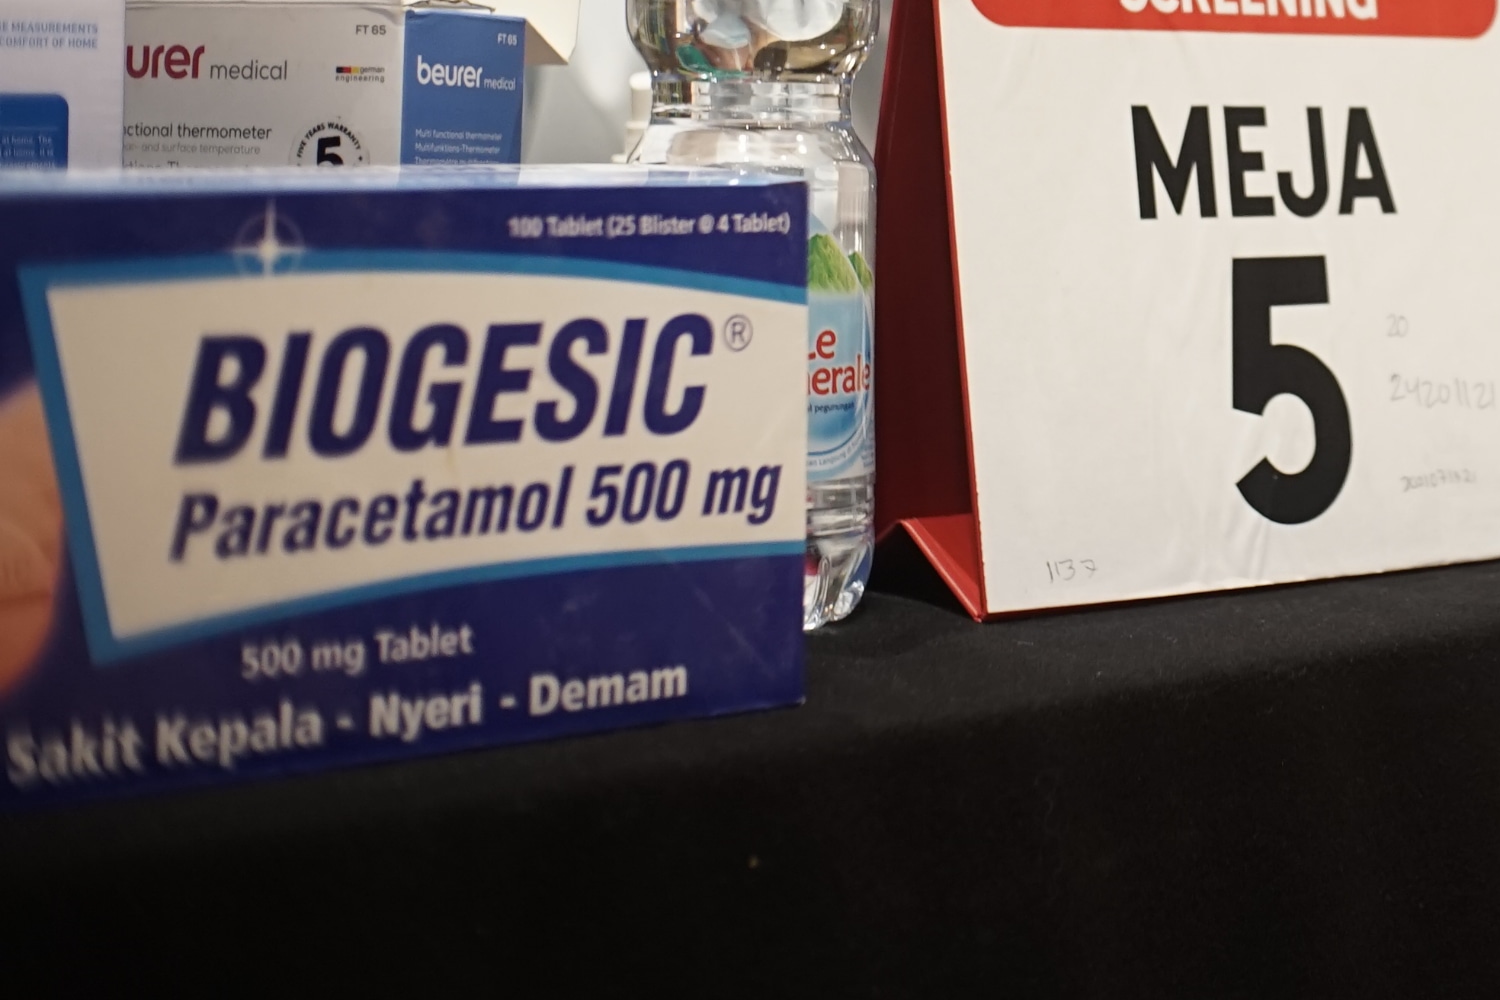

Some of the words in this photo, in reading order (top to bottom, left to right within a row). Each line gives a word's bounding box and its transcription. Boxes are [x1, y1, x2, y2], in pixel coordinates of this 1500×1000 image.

[12, 21, 98, 34] MEASUREMENTS
[355, 25, 370, 35] FT
[371, 24, 387, 35] 65
[497, 33, 507, 45] FT
[507, 34, 518, 46] 65
[52, 37, 65, 48] OF
[68, 38, 98, 49] HOME
[126, 45, 205, 80] urer
[210, 60, 287, 81] medical
[417, 55, 483, 88] beurer
[484, 77, 516, 91] medical
[123, 123, 173, 138] ctional
[177, 123, 272, 139] thermometer
[327, 121, 361, 150] WARRANTY
[141, 142, 159, 152] and
[162, 142, 198, 154] surface
[199, 144, 261, 157] temperature
[1130, 104, 1398, 221] MEJA
[508, 215, 543, 239] 100
[546, 215, 604, 238] Tablet
[606, 214, 635, 239] (25
[639, 213, 697, 236] Blister
[716, 214, 729, 234] 4
[731, 212, 791, 235] Tablet)
[1232, 254, 1354, 525] 5
[170, 469, 567, 562] Paracetamol
[586, 458, 687, 527] 500
[702, 461, 783, 523] mg
[240, 643, 302, 680] 500
[310, 641, 366, 676] mg
[376, 623, 473, 664] Tablet
[5, 719, 142, 787] Sakit
[154, 701, 325, 769] Kepala
[367, 683, 484, 743] Nyeri
[527, 665, 690, 717] Demam
